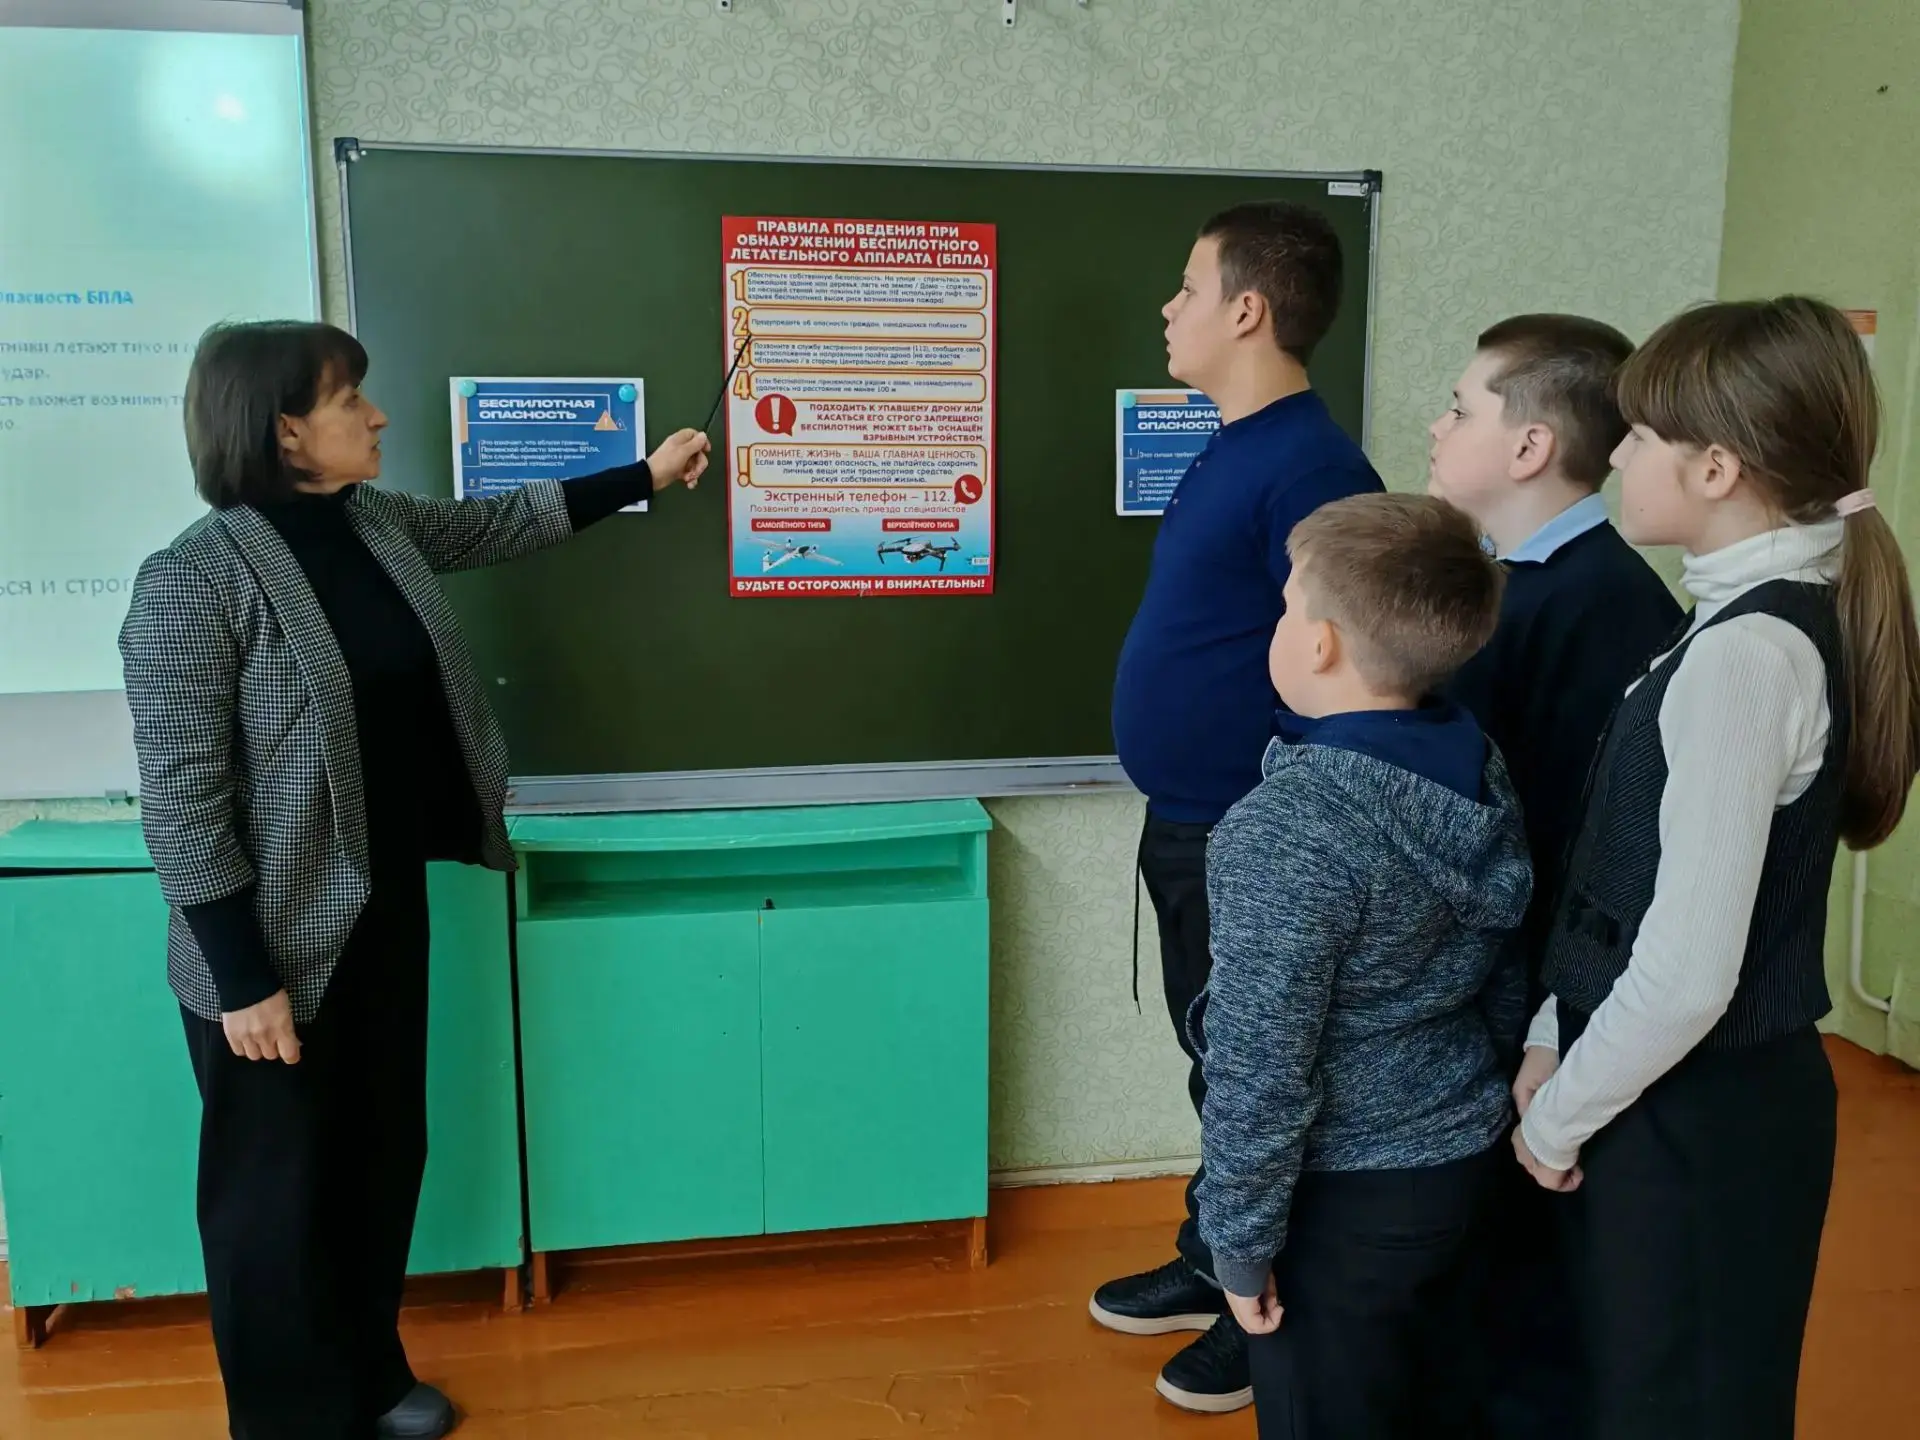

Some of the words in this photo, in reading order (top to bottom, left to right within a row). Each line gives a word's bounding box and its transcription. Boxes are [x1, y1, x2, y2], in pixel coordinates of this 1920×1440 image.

[756, 220, 829, 233] ПРАВИЛА
[834, 223, 925, 236] ПОВЕДЕНИЯ
[929, 226, 959, 238] ПРИ
[736, 234, 855, 249] ОБНАРУЖЕНИИ
[859, 237, 979, 251] БЕСПИЛОТНОГО
[730, 248, 849, 262] ЛЕТАТЕЛЬНОГО
[853, 251, 932, 264] АППАРАТА
[936, 253, 989, 268] (БПЛА)
[731, 270, 745, 301] 1
[86, 289, 134, 304] БПЛА
[732, 306, 749, 336] 2
[53, 341, 117, 354] летают
[733, 370, 749, 400] 4
[478, 399, 595, 409] БЕСПИЛОТНАЯ
[931, 405, 962, 413] ДРОНУ
[479, 410, 577, 420] ОПАСНОСТЬ
[937, 424, 983, 432] ОСНАЩЁН
[1137, 421, 1221, 430] ОПАСНОСТЬ
[863, 433, 915, 441] ВЗРЫВНЫМ
[806, 449, 841, 458] ЖИЗНЬ
[852, 450, 880, 458] ВАША
[882, 450, 925, 458] ГЛАВНАЯ
[858, 468, 915, 476] транспортное
[764, 490, 845, 504] Экстренный
[849, 490, 907, 504] телефон
[923, 490, 951, 502] 112.
[749, 504, 799, 513] Позвоните
[863, 506, 901, 514] приезда
[903, 506, 966, 514] специалистов
[755, 520, 806, 529] САМОЛЁТНОГО
[807, 521, 826, 529] ТИПА
[886, 520, 936, 529] ВЕРТОЛЁТНОГО
[937, 521, 955, 529] ТИПА
[42, 579, 56, 595] и
[736, 580, 785, 592] БУДЬТЕ
[787, 580, 872, 591] ОСТОРОЖНЫ
[874, 580, 884, 589] И
[886, 579, 985, 589] ВНИМАТЕЛЬНЫ!
